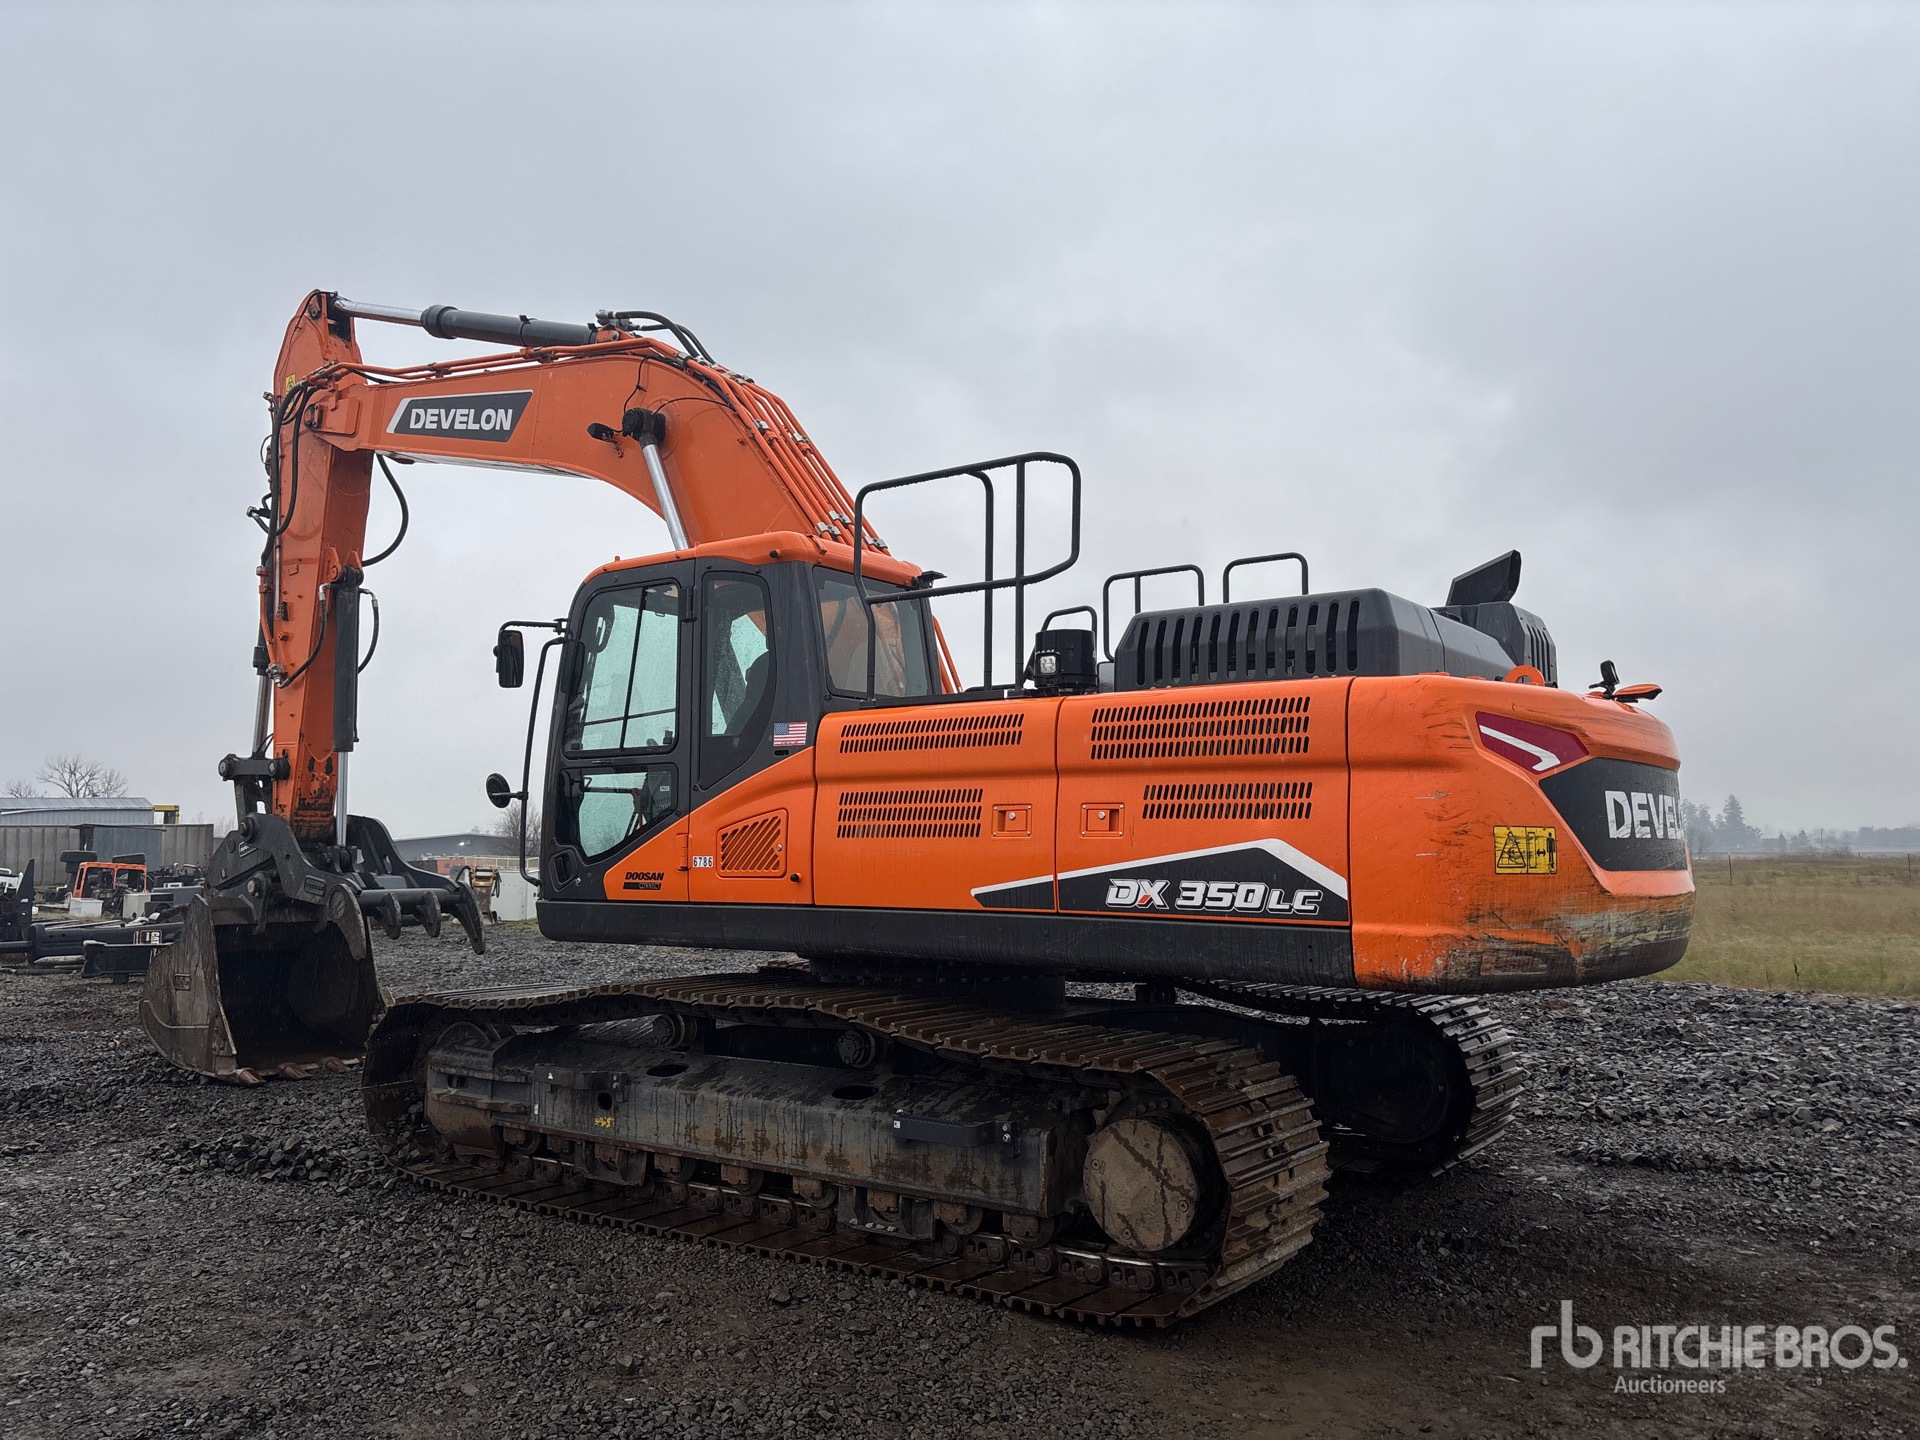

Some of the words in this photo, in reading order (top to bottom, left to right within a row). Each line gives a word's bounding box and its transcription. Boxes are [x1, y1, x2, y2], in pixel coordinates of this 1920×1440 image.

[409, 408, 513, 431] DEVELON
[693, 857, 713, 867] 6786
[625, 872, 664, 881] DOOSAN
[1105, 878, 1170, 909] DX
